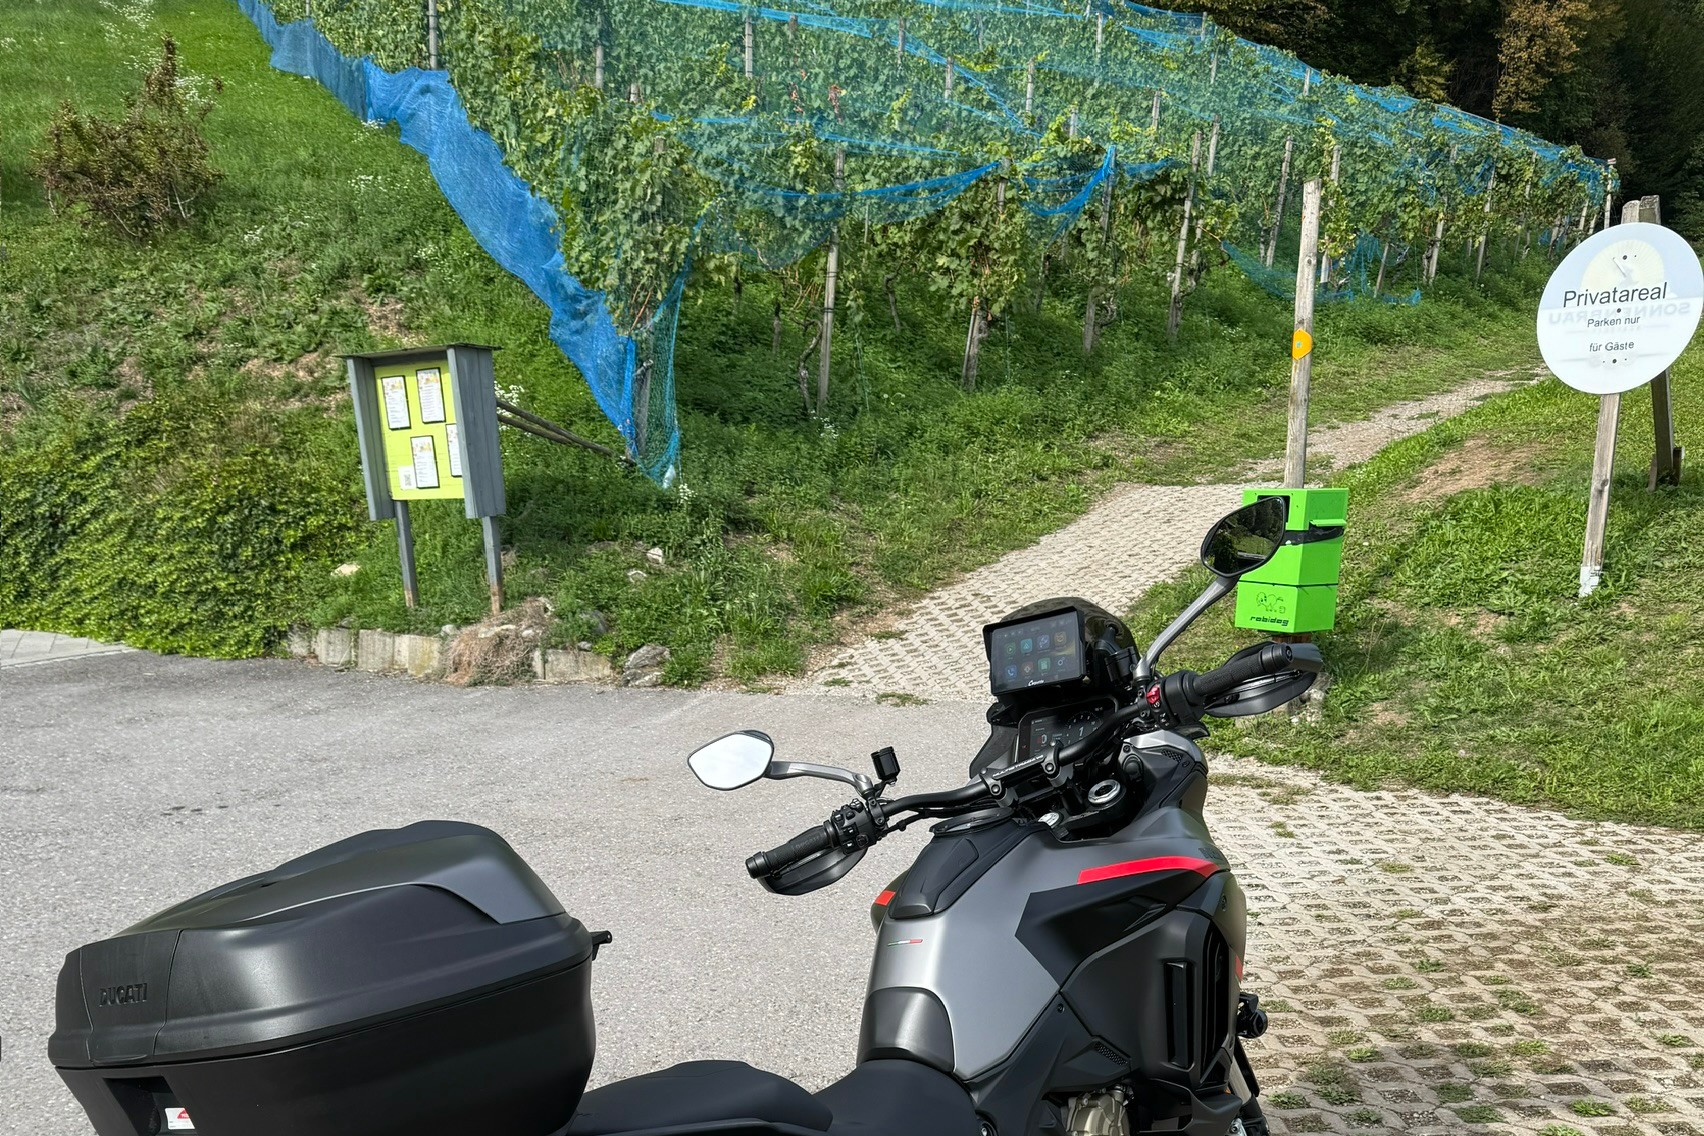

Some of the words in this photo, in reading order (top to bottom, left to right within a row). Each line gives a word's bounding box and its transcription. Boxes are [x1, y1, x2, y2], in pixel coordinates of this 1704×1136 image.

[1563, 282, 1667, 307] Privatareal
[1587, 318, 1621, 328] Parken
[1625, 315, 1641, 324] nur
[1589, 342, 1602, 352] für
[1605, 341, 1635, 352] Gäste
[1250, 616, 1289, 626] robidog
[99, 983, 147, 1007] DUCATI
